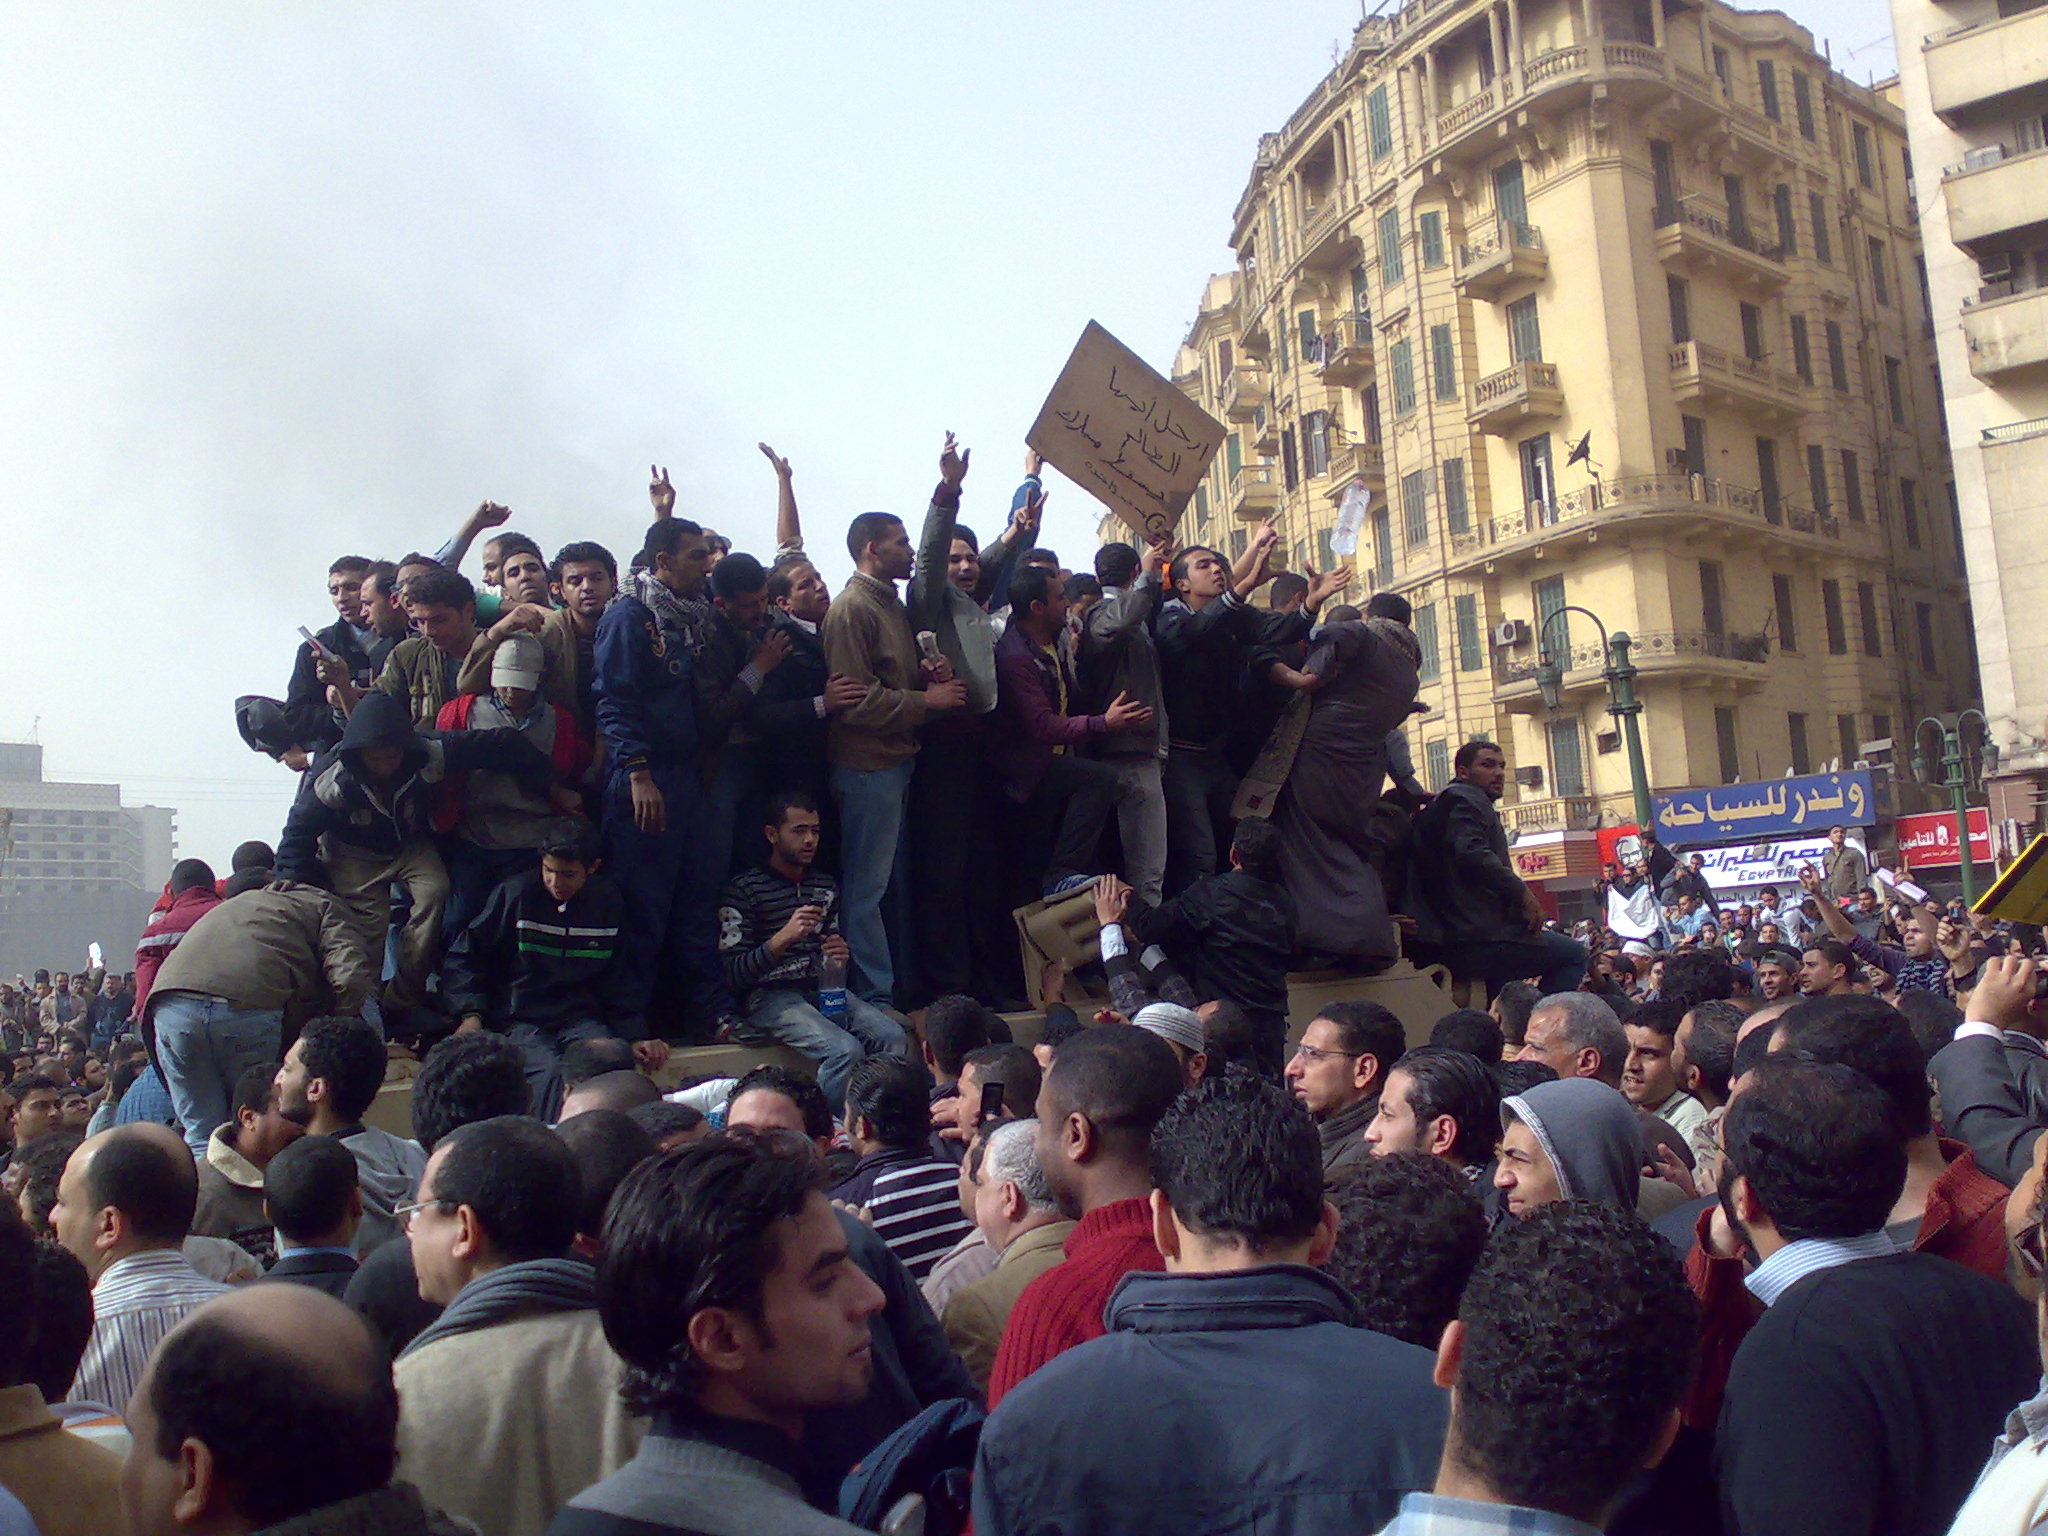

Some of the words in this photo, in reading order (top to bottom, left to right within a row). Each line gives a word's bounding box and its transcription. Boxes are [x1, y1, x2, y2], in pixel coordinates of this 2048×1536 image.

[1659, 783, 1787, 832] للسياحة
[1792, 776, 1865, 824] وندر
[1737, 864, 1803, 882] EGYPTAI
